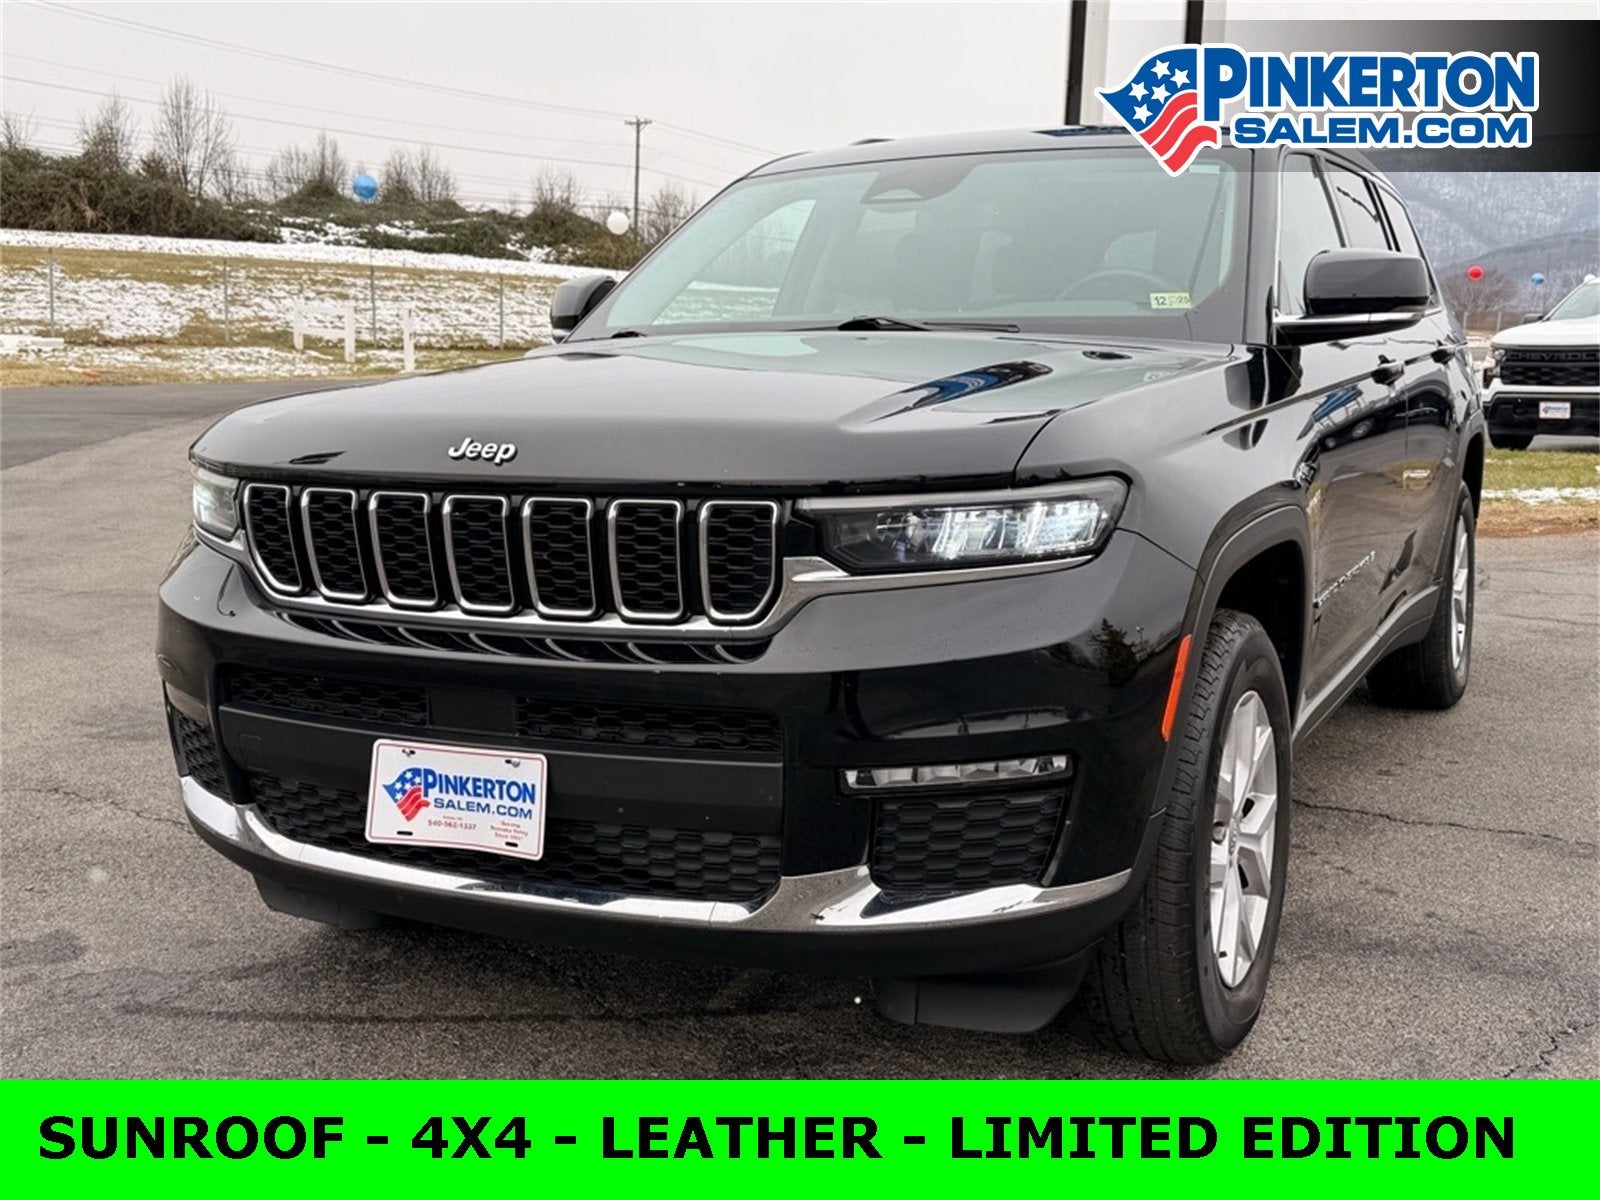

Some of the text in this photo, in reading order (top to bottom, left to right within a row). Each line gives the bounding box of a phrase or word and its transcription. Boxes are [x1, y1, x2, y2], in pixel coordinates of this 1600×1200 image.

[1154, 296, 1167, 305] 12
[447, 437, 518, 465] Jeep
[423, 768, 536, 804] PINKERTON
[433, 797, 532, 820] SALEM.COM
